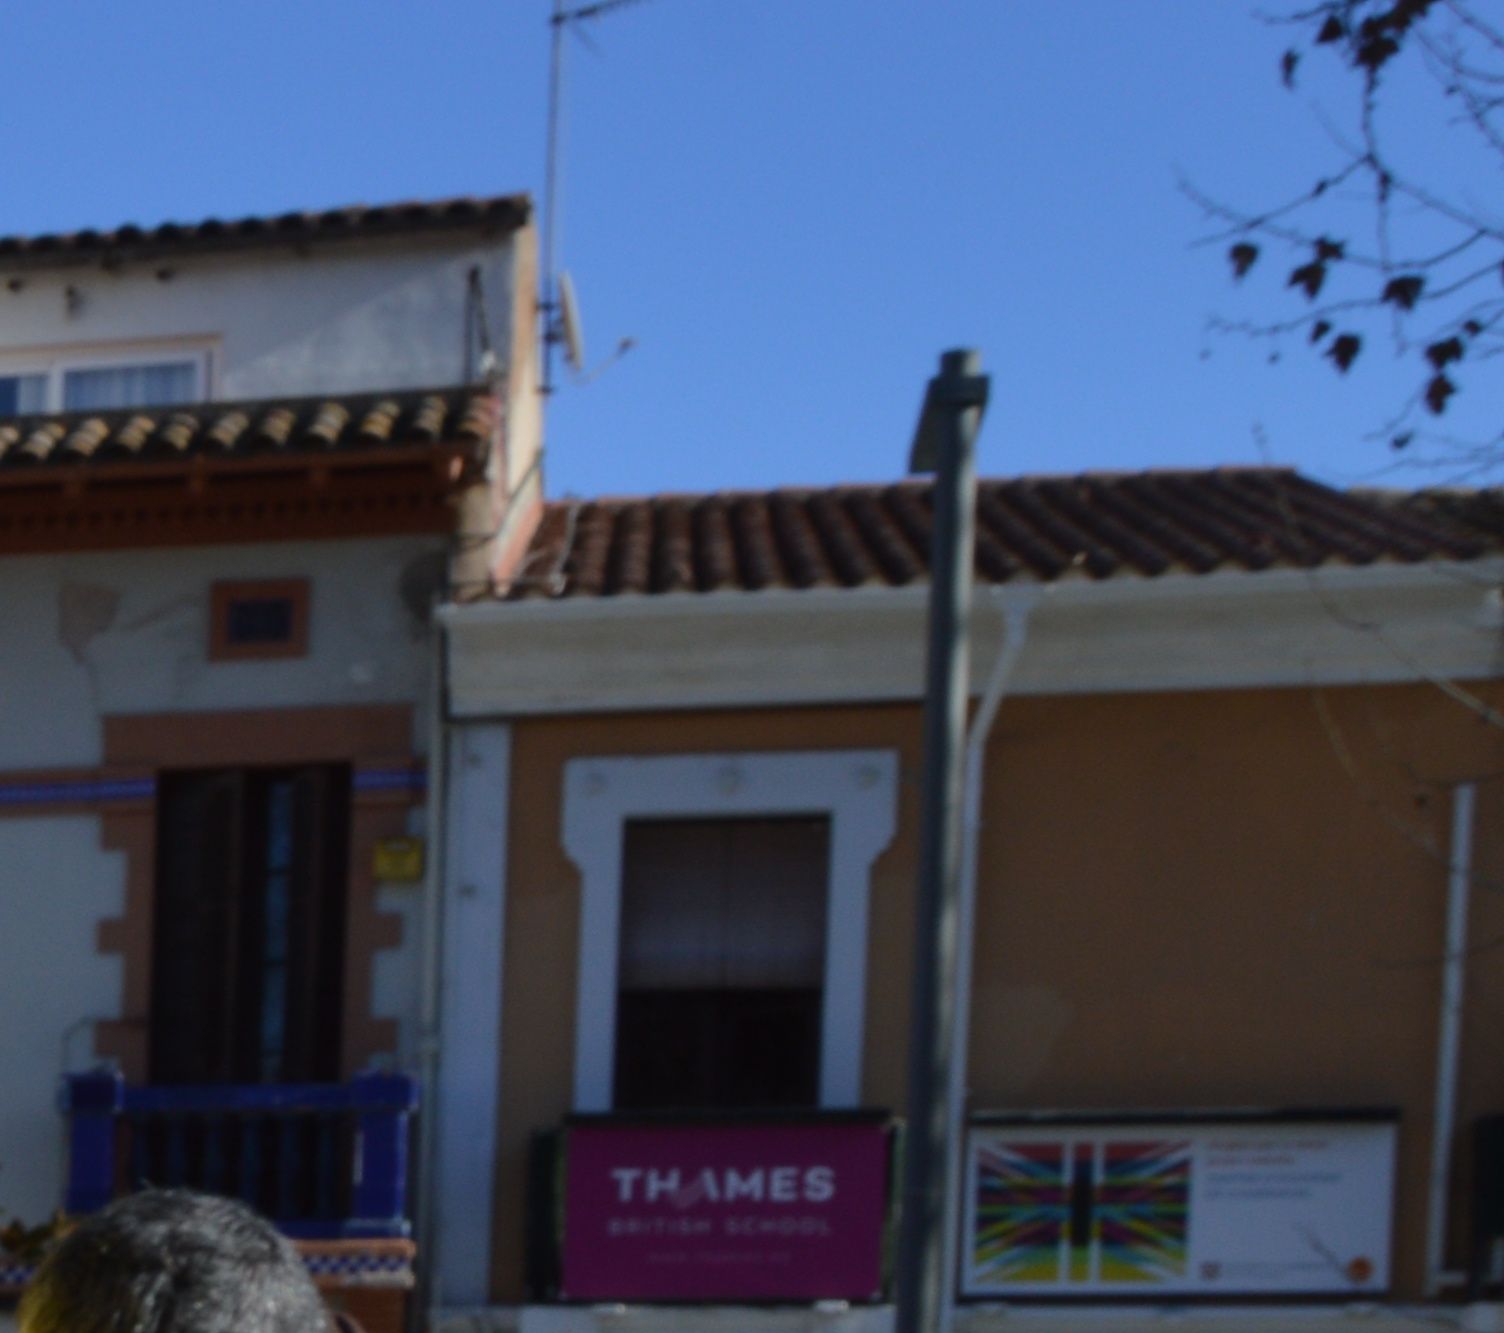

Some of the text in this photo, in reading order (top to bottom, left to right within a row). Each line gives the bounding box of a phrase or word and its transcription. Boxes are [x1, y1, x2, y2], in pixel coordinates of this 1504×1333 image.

[611, 1166, 835, 1205] THAMES
[607, 1216, 831, 1237] BRITISH SCHOOL
